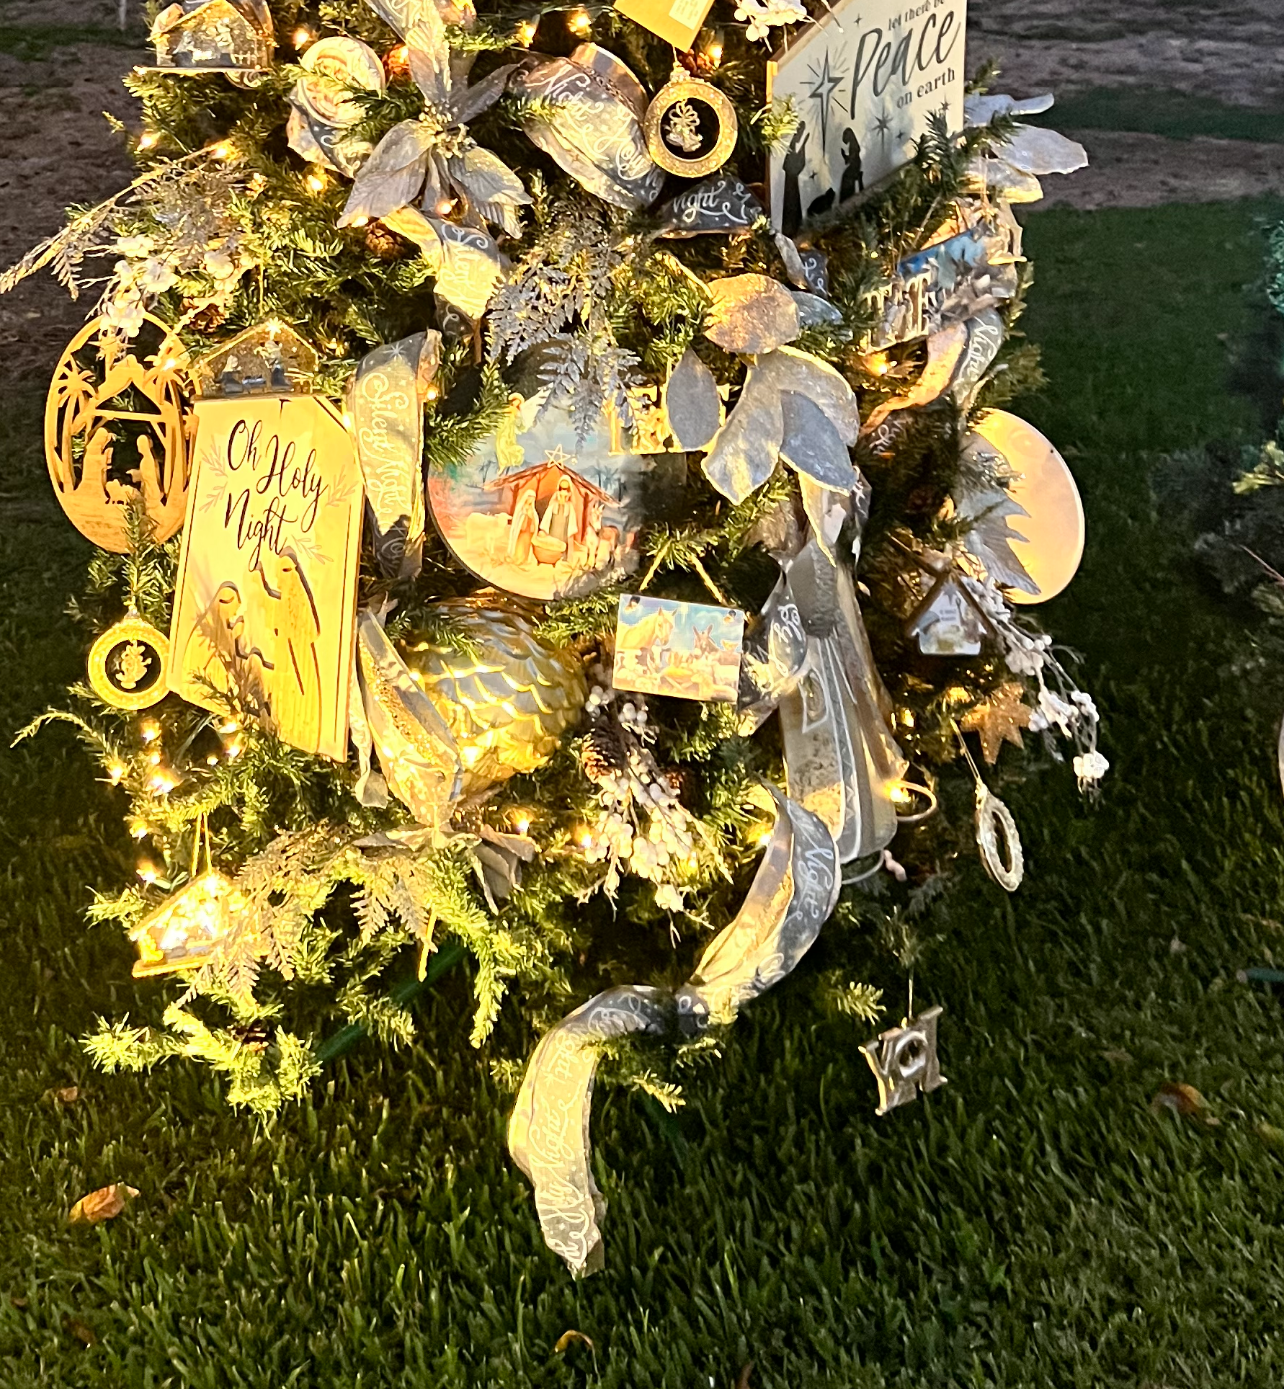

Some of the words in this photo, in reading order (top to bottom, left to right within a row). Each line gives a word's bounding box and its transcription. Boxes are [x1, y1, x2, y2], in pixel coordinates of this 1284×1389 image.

[888, 13, 902, 32] let
[850, 10, 962, 121] Peace
[896, 91, 913, 109] on
[916, 67, 955, 99] earth
[227, 419, 262, 471] Oh
[359, 372, 411, 456] Silent
[256, 434, 329, 533] Holy
[224, 488, 299, 572] Night
